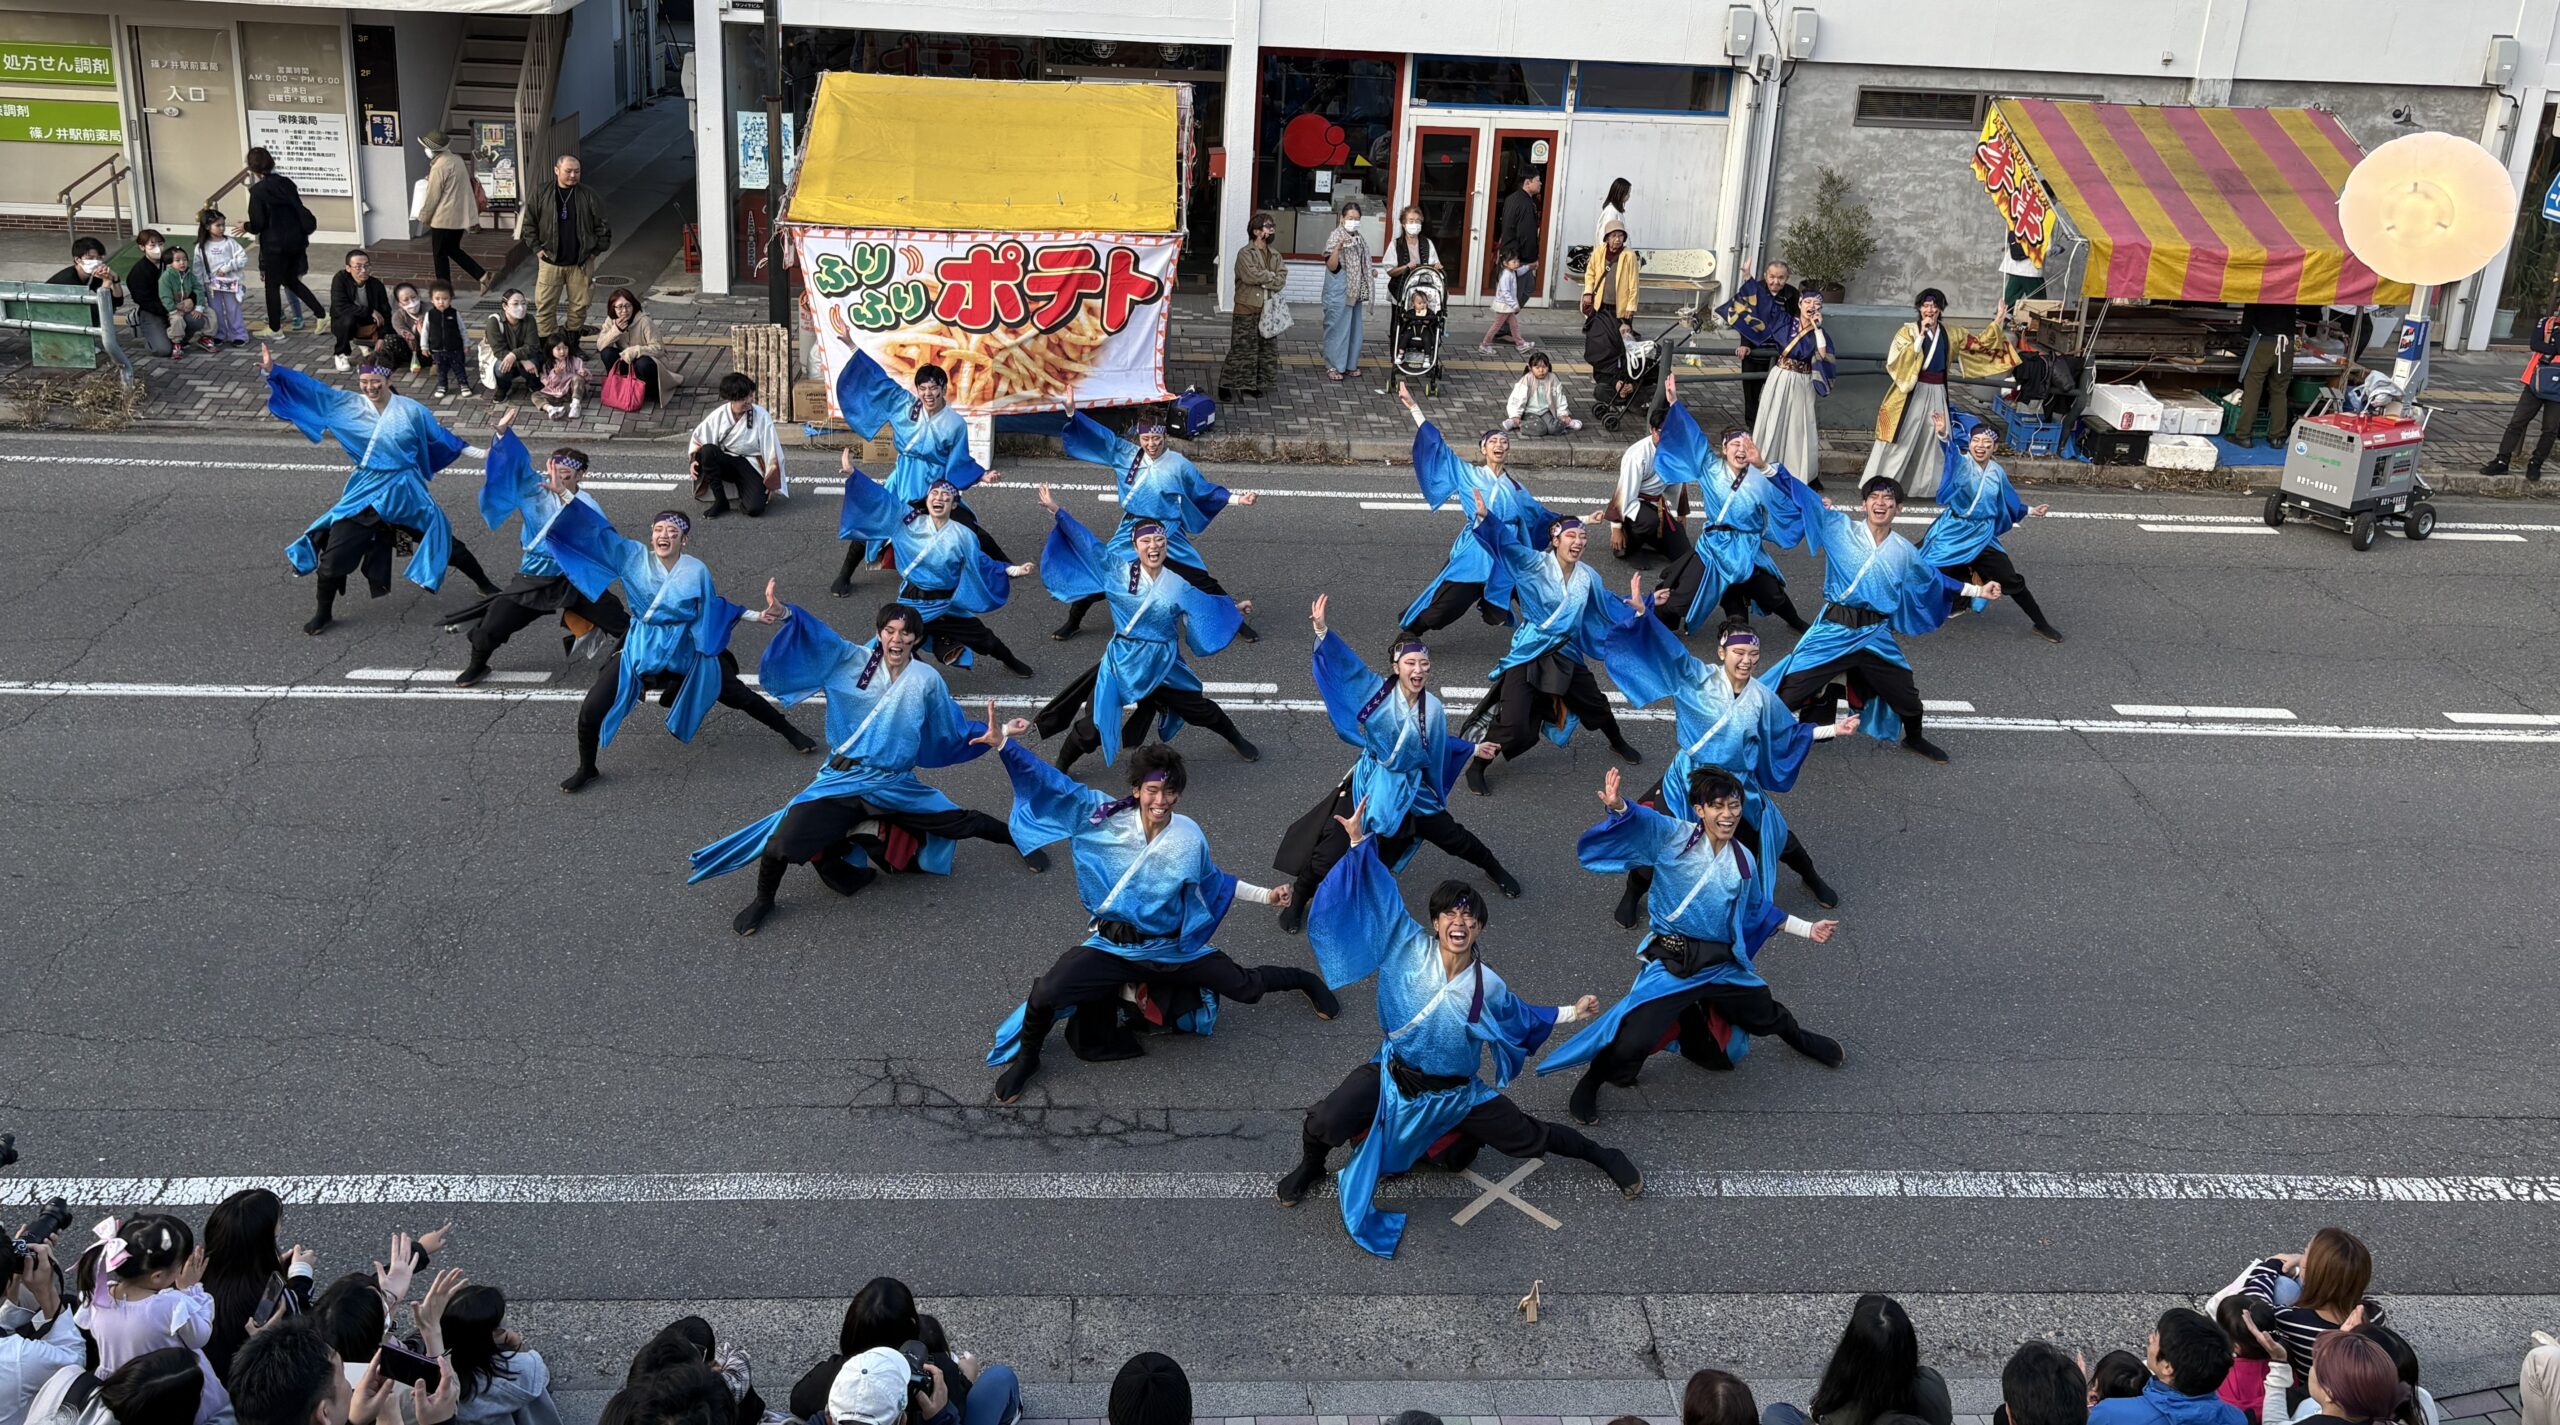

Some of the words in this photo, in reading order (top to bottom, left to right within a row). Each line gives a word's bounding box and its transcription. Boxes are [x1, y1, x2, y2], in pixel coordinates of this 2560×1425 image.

[358, 34, 369, 42] 3F
[3, 54, 110, 75] 処方せん調剤
[265, 74, 288, 82] 9:00
[301, 76, 315, 84] PM
[317, 77, 340, 85] 6:00
[361, 69, 371, 77] 2F
[168, 85, 205, 102] 入口
[283, 86, 307, 95] 定休日
[0, 104, 30, 118] 調剤
[278, 115, 318, 125] 保険薬局
[29, 126, 122, 142] 篠ノ井駅前薬局
[372, 116, 383, 144] 受付
[383, 116, 394, 144] 処方せん
[814, 242, 892, 294] ふり
[934, 243, 1161, 332] ポテト
[850, 281, 926, 329] ふり
